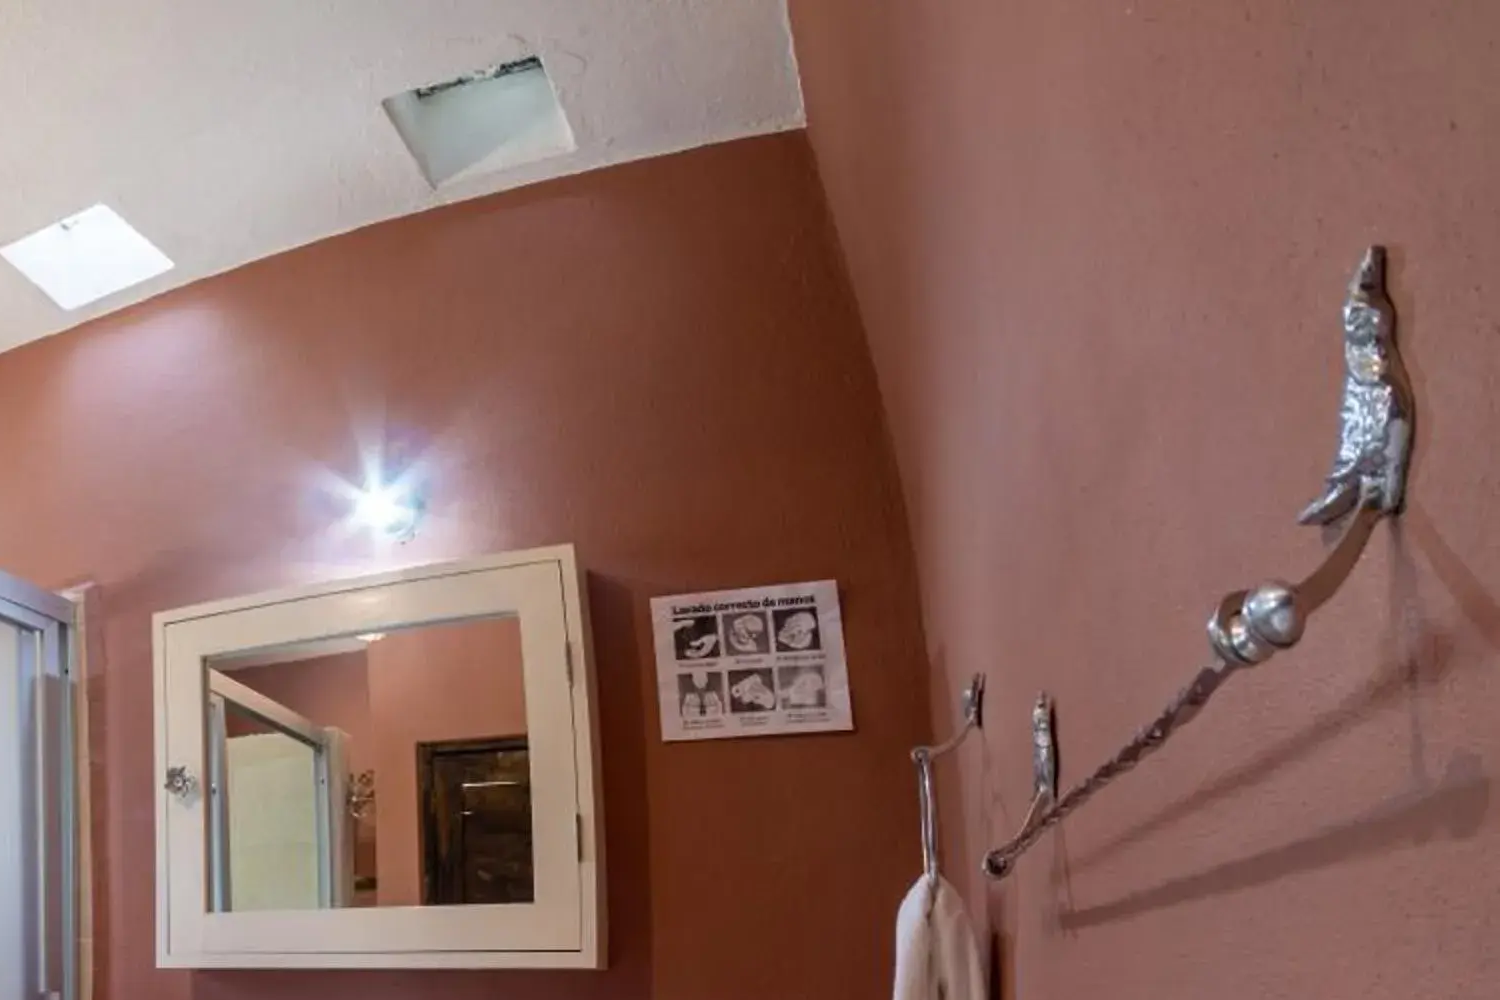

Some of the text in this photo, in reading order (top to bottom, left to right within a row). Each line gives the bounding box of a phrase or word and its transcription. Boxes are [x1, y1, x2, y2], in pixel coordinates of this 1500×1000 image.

[673, 594, 815, 615] Lavado correcto de manos
